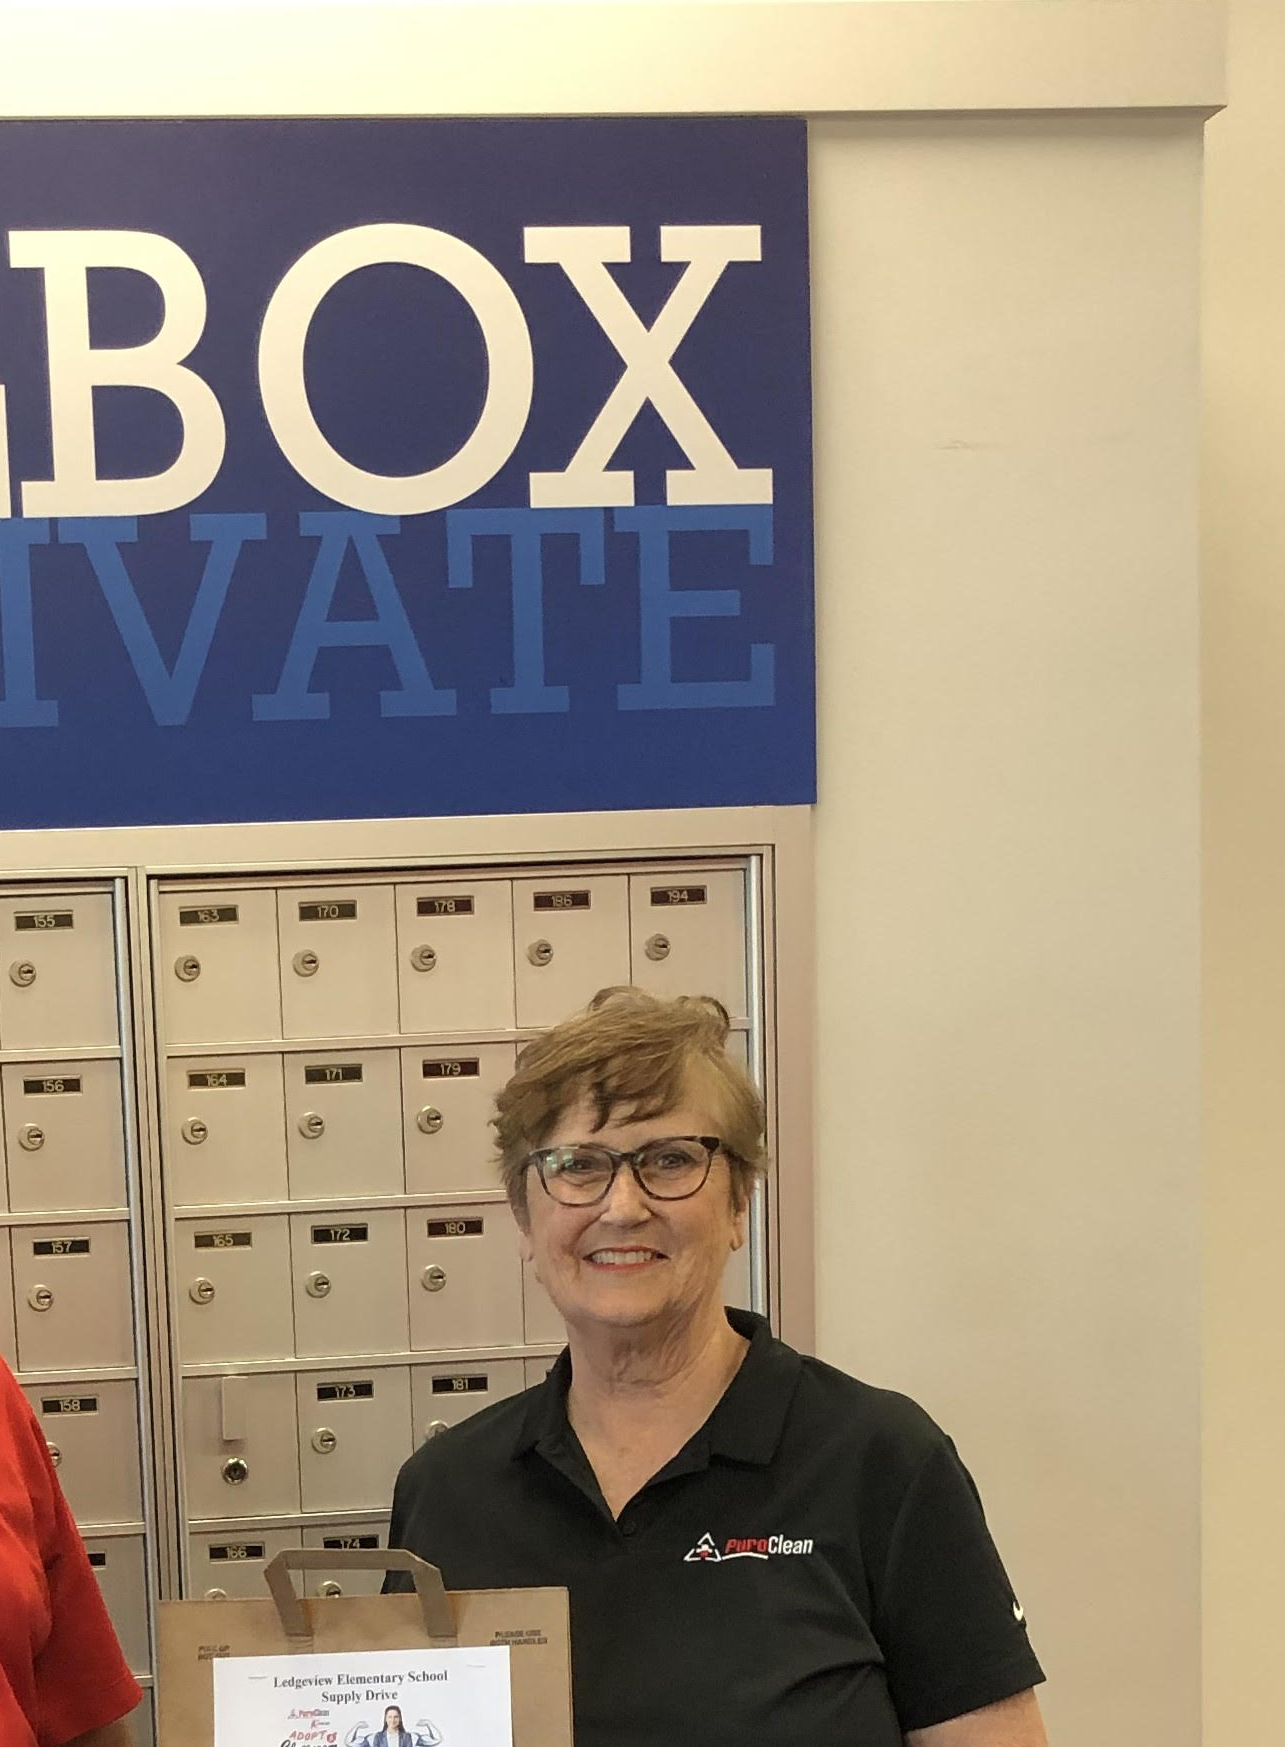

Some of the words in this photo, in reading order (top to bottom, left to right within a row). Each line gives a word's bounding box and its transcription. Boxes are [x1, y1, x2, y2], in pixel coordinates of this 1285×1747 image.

[667, 890, 688, 902] 194
[317, 905, 339, 918] 170
[434, 900, 456, 913] 178
[33, 916, 55, 928] 155
[197, 909, 221, 923] 163
[324, 1067, 344, 1081] 171
[439, 1062, 462, 1076] 179
[43, 1080, 65, 1093] 156
[205, 1073, 229, 1087] 164
[444, 1221, 466, 1234] 180
[212, 1234, 234, 1247] 165
[329, 1228, 351, 1241] 172
[51, 1240, 73, 1253] 157
[451, 1378, 469, 1391] 181
[334, 1386, 356, 1399] 173
[59, 1399, 80, 1412] 158
[225, 1546, 248, 1559] 166
[274, 1675, 333, 1689] Ledgeview
[337, 1672, 405, 1686] Elementary
[408, 1670, 448, 1682] School
[322, 1690, 362, 1705] Supply
[366, 1689, 398, 1701] Drive
